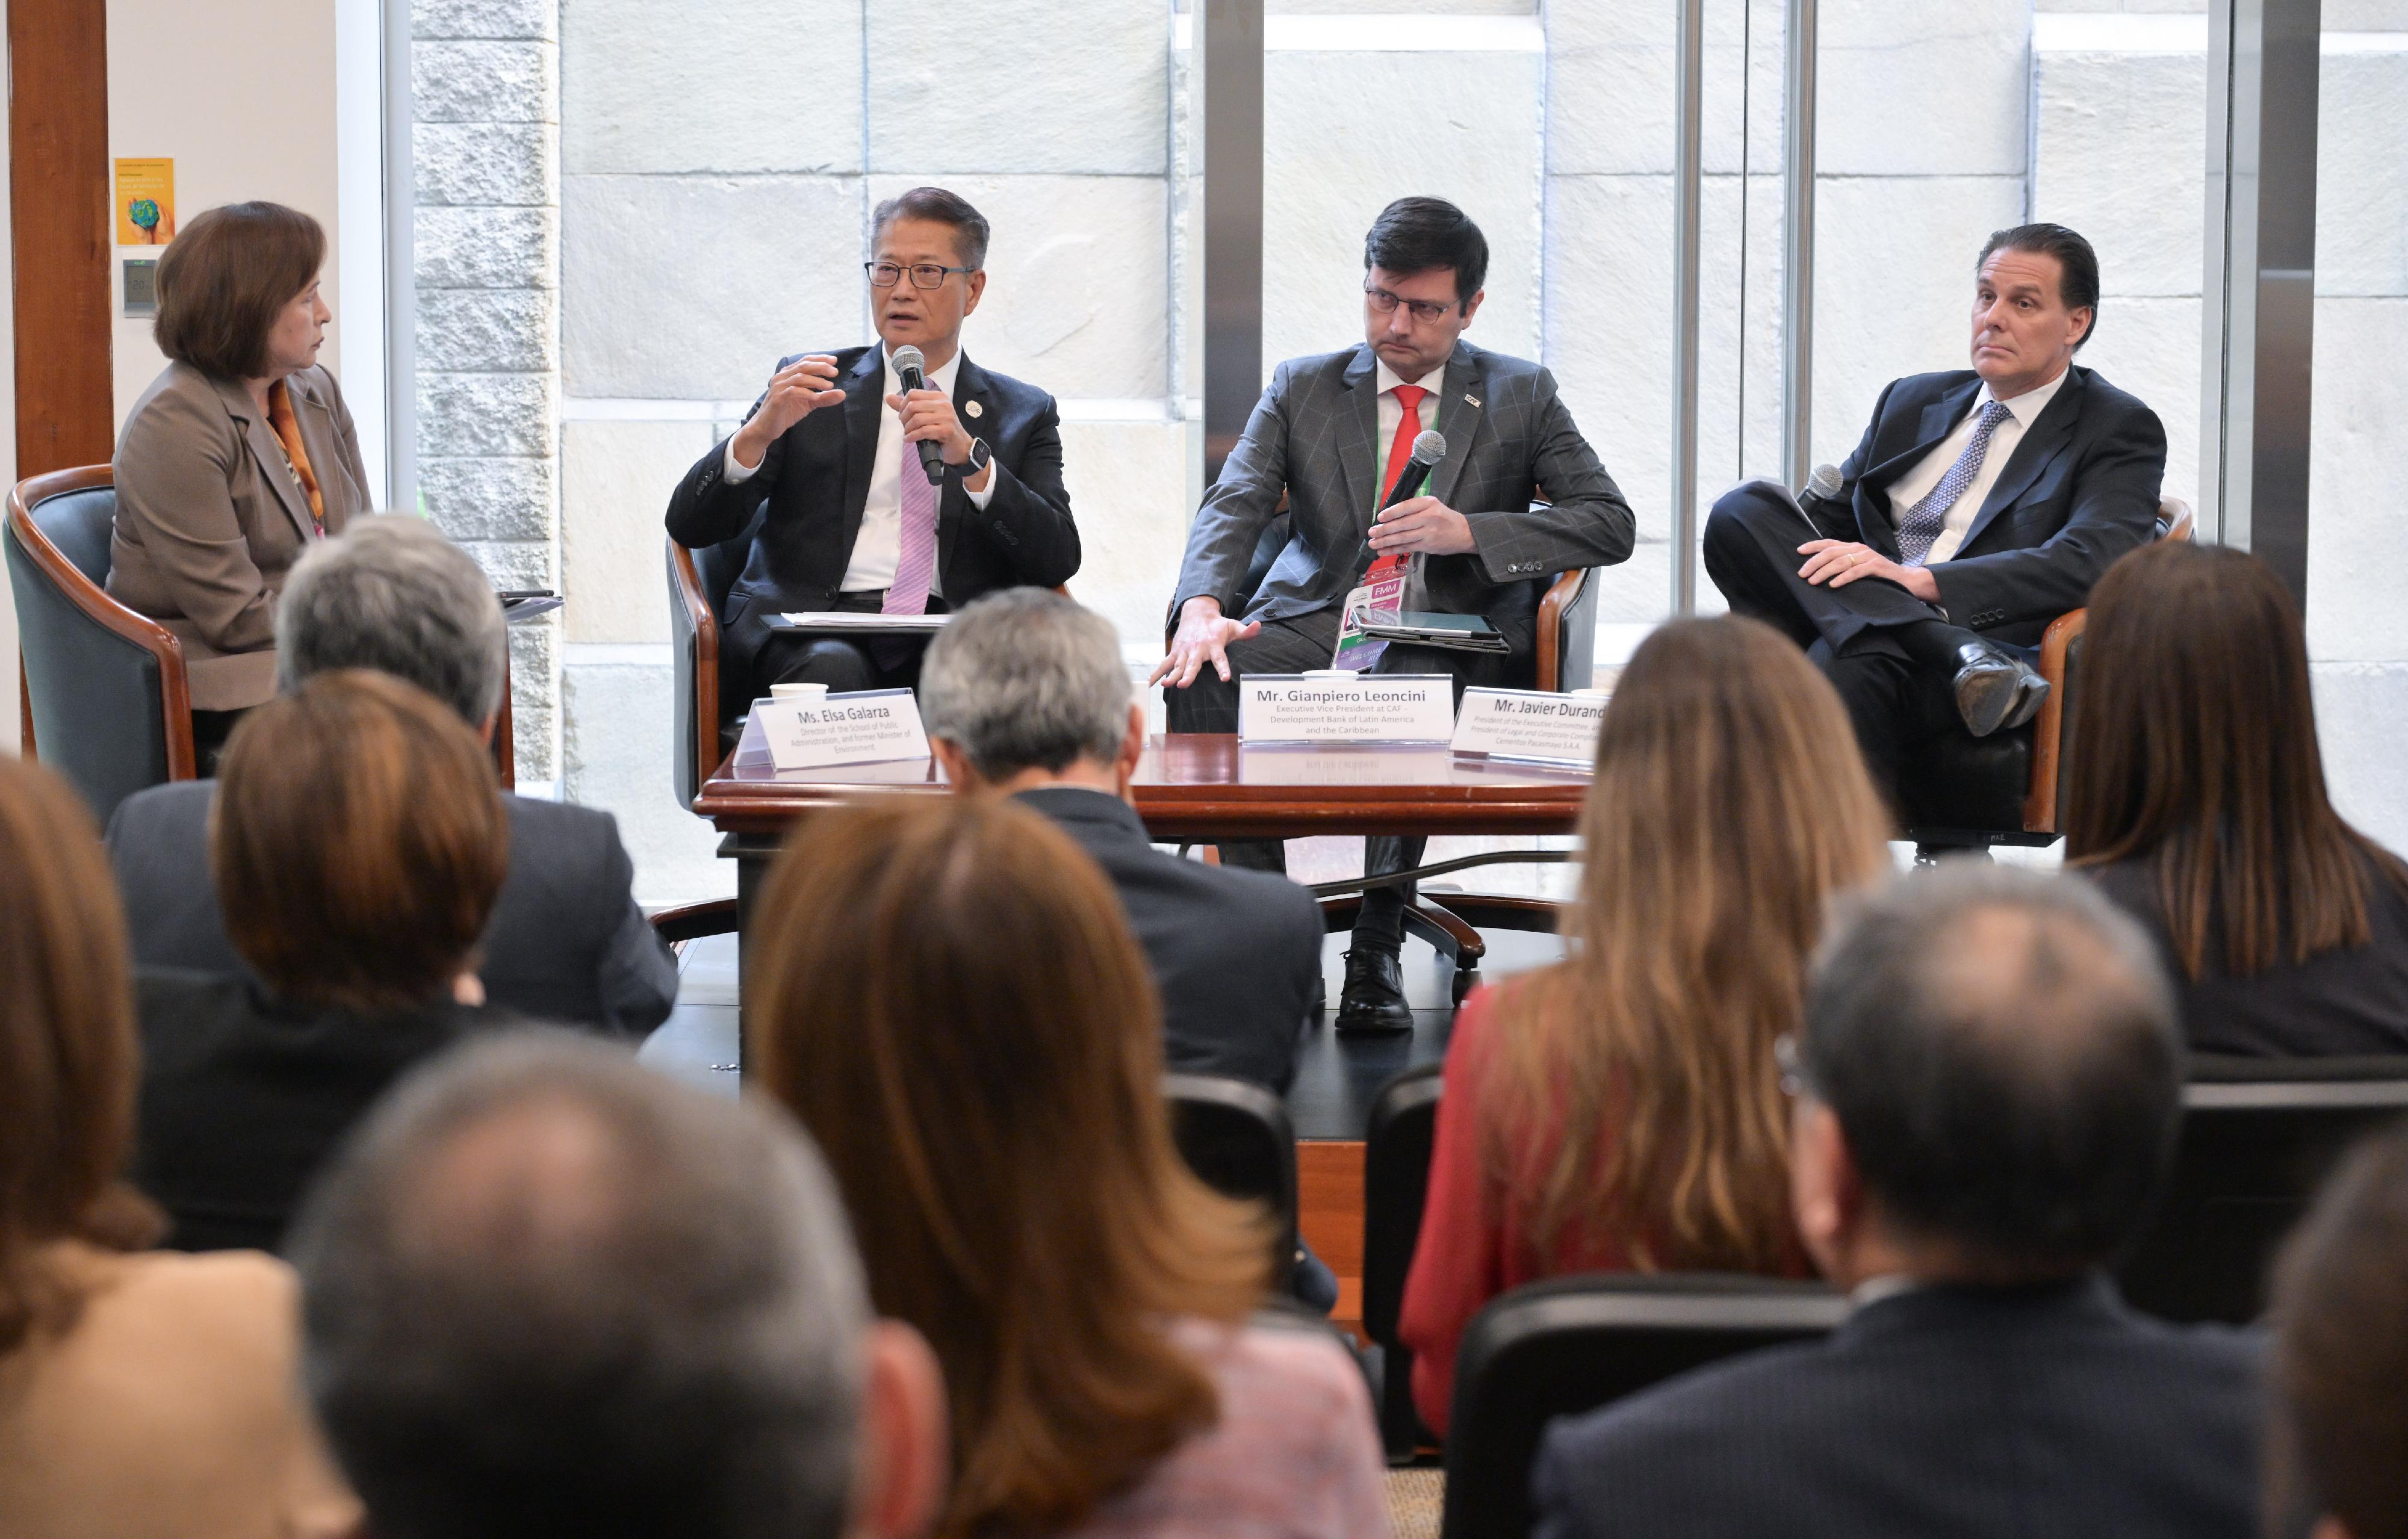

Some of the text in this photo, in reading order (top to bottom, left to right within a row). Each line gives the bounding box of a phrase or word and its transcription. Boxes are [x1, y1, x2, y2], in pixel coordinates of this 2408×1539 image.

[1375, 583, 1397, 595] FMM
[1257, 690, 1425, 704] Mr. Gianpiero Leoncini
[1495, 699, 1515, 712] Mr.
[1519, 701, 1556, 714] Javier
[798, 706, 890, 723] Ms. Elsa Galarza
[849, 723, 870, 732] School
[791, 738, 841, 746] Administration,
[904, 729, 911, 738] of
[1495, 737, 1525, 745] Cementos
[1538, 730, 1569, 739] Corporate
